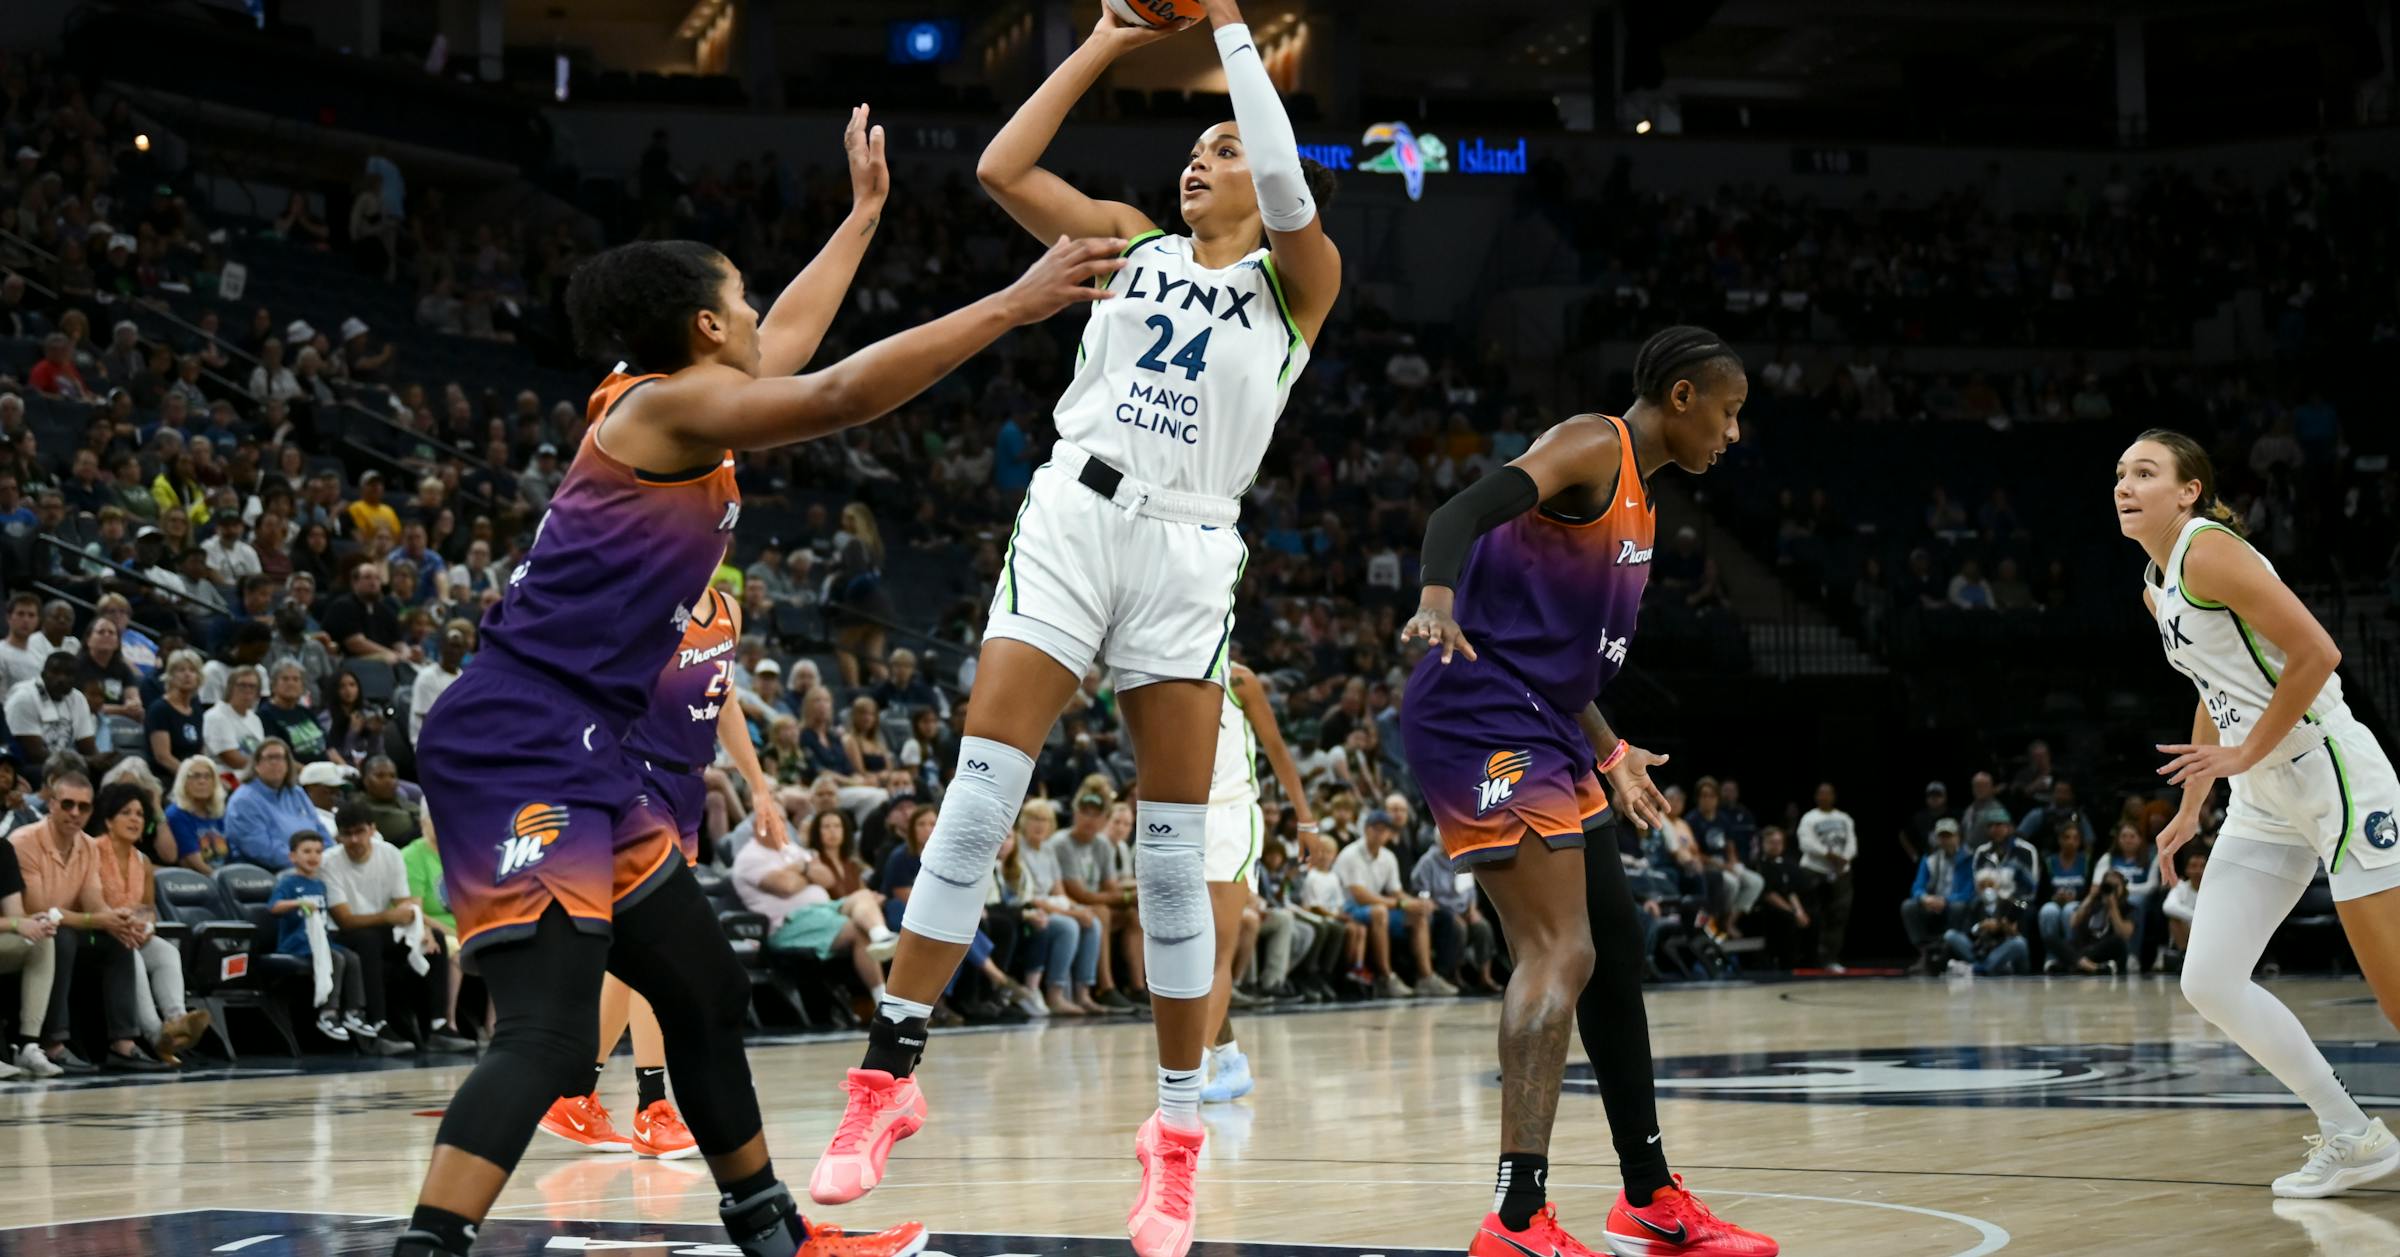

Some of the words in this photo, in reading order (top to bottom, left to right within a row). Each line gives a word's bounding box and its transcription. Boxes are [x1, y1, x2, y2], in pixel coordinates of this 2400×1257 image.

[1298, 144, 1353, 170] sure
[1458, 137, 1527, 173] Island
[1125, 266, 1257, 330] LYNX
[1135, 313, 1213, 382] 24
[1129, 381, 1199, 417] MAYO
[1116, 403, 1199, 445] CLINIC
